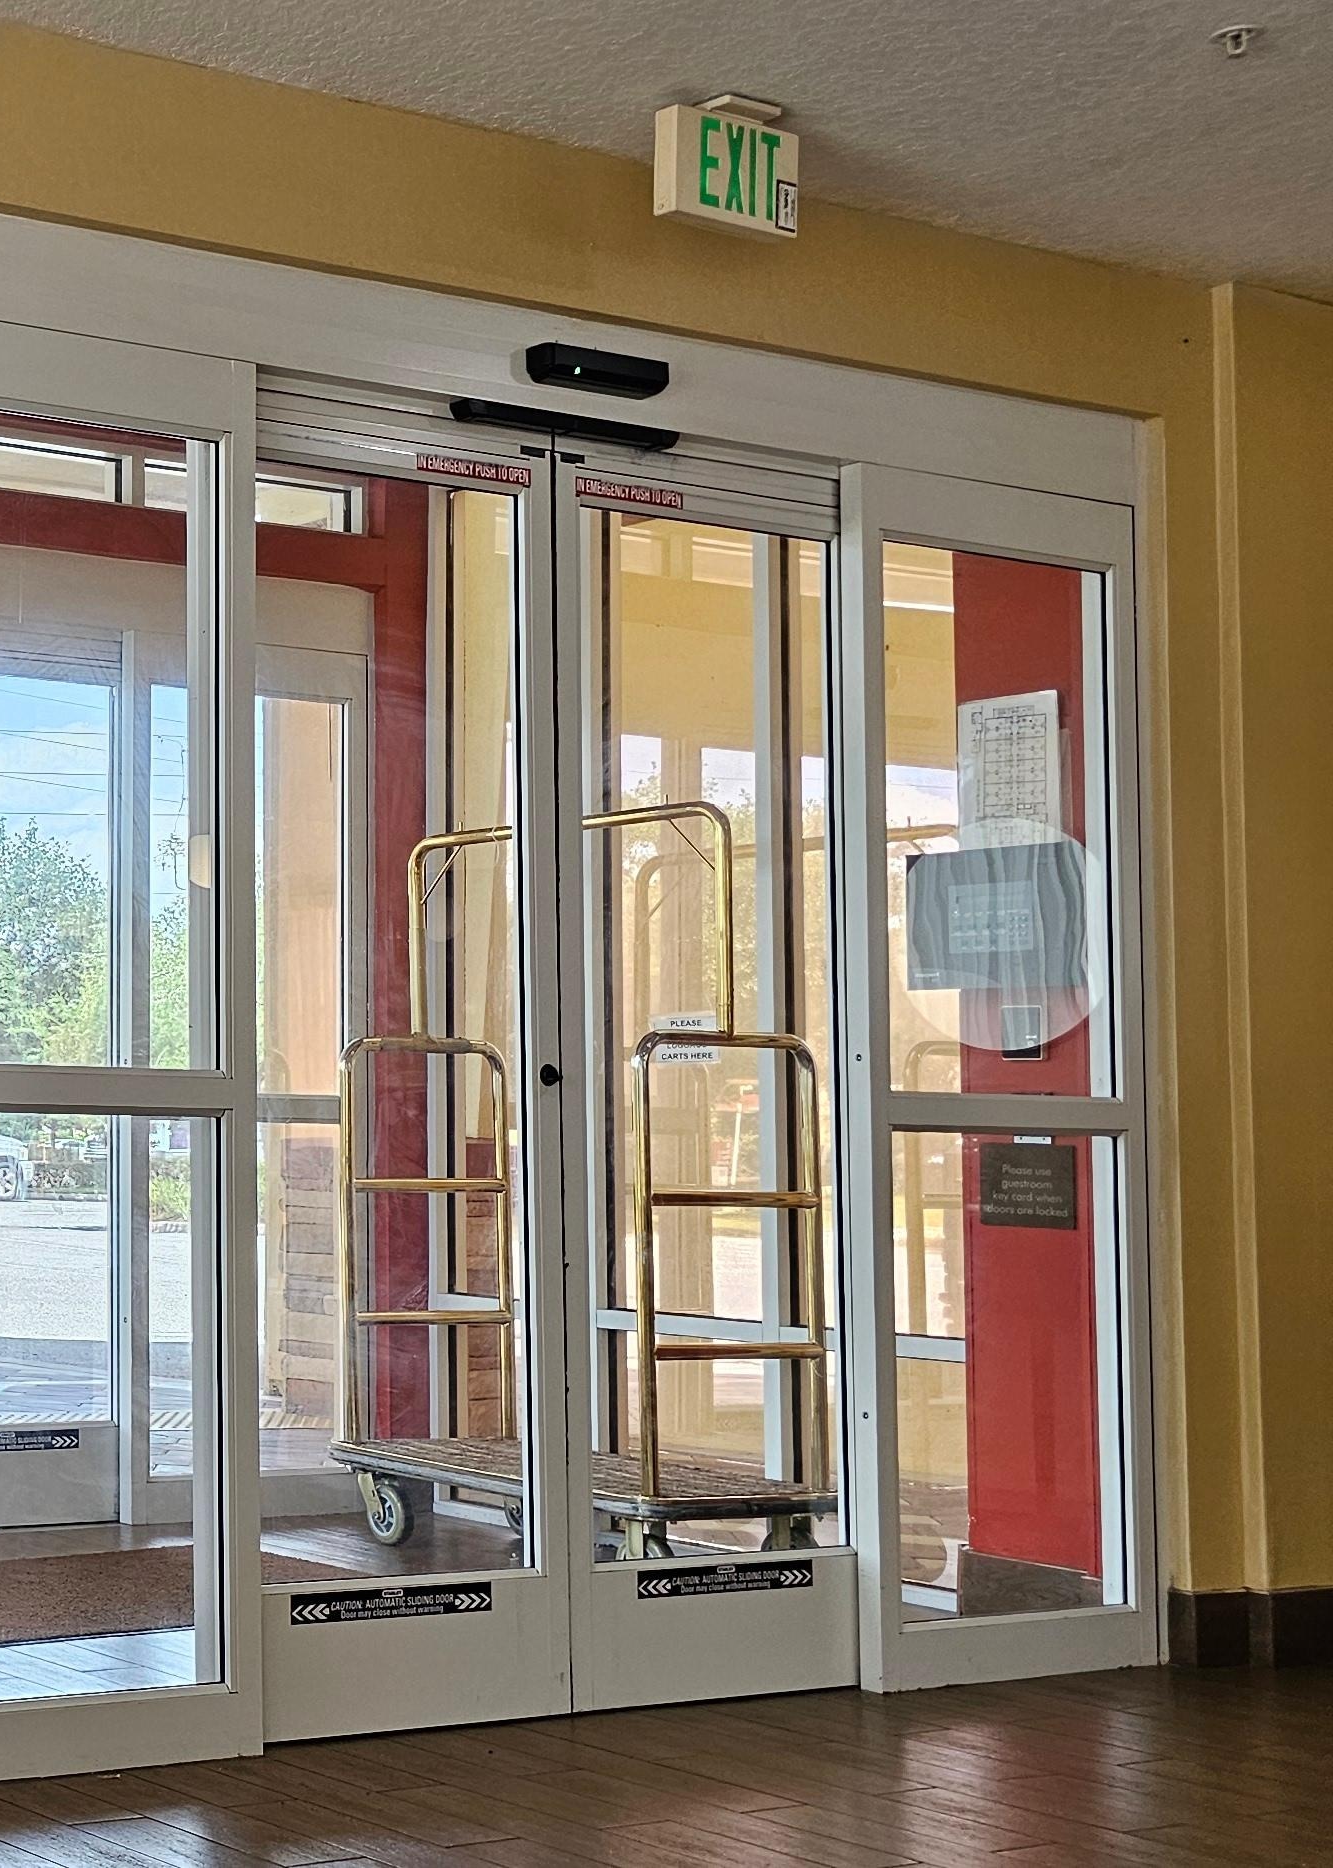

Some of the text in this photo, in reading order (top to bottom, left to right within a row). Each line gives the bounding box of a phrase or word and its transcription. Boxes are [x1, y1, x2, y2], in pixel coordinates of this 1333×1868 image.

[699, 116, 780, 221] EXIT
[417, 454, 529, 485] IN EMERGENCY PUSH TO OPEN
[576, 478, 682, 508] IN EMERGENCY PUSH TO OPEN
[670, 1019, 702, 1027] PLEASE
[1002, 1164, 1052, 1176] Please use
[1002, 1180, 1053, 1189] guestroom
[993, 1190, 1062, 1203] key card when
[986, 1203, 1068, 1217] doors are locked
[702, 1574, 737, 1583] AUTOMATIC
[739, 1571, 762, 1580] SLIDING
[763, 1570, 780, 1579] DOOR
[680, 1585, 694, 1593] Door
[709, 1583, 724, 1591] close
[366, 1597, 406, 1608] AUTOMATIC
[408, 1595, 434, 1605] SLIDING
[435, 1594, 454, 1603] DOOR
[341, 1605, 444, 1619] Door may close without warning
